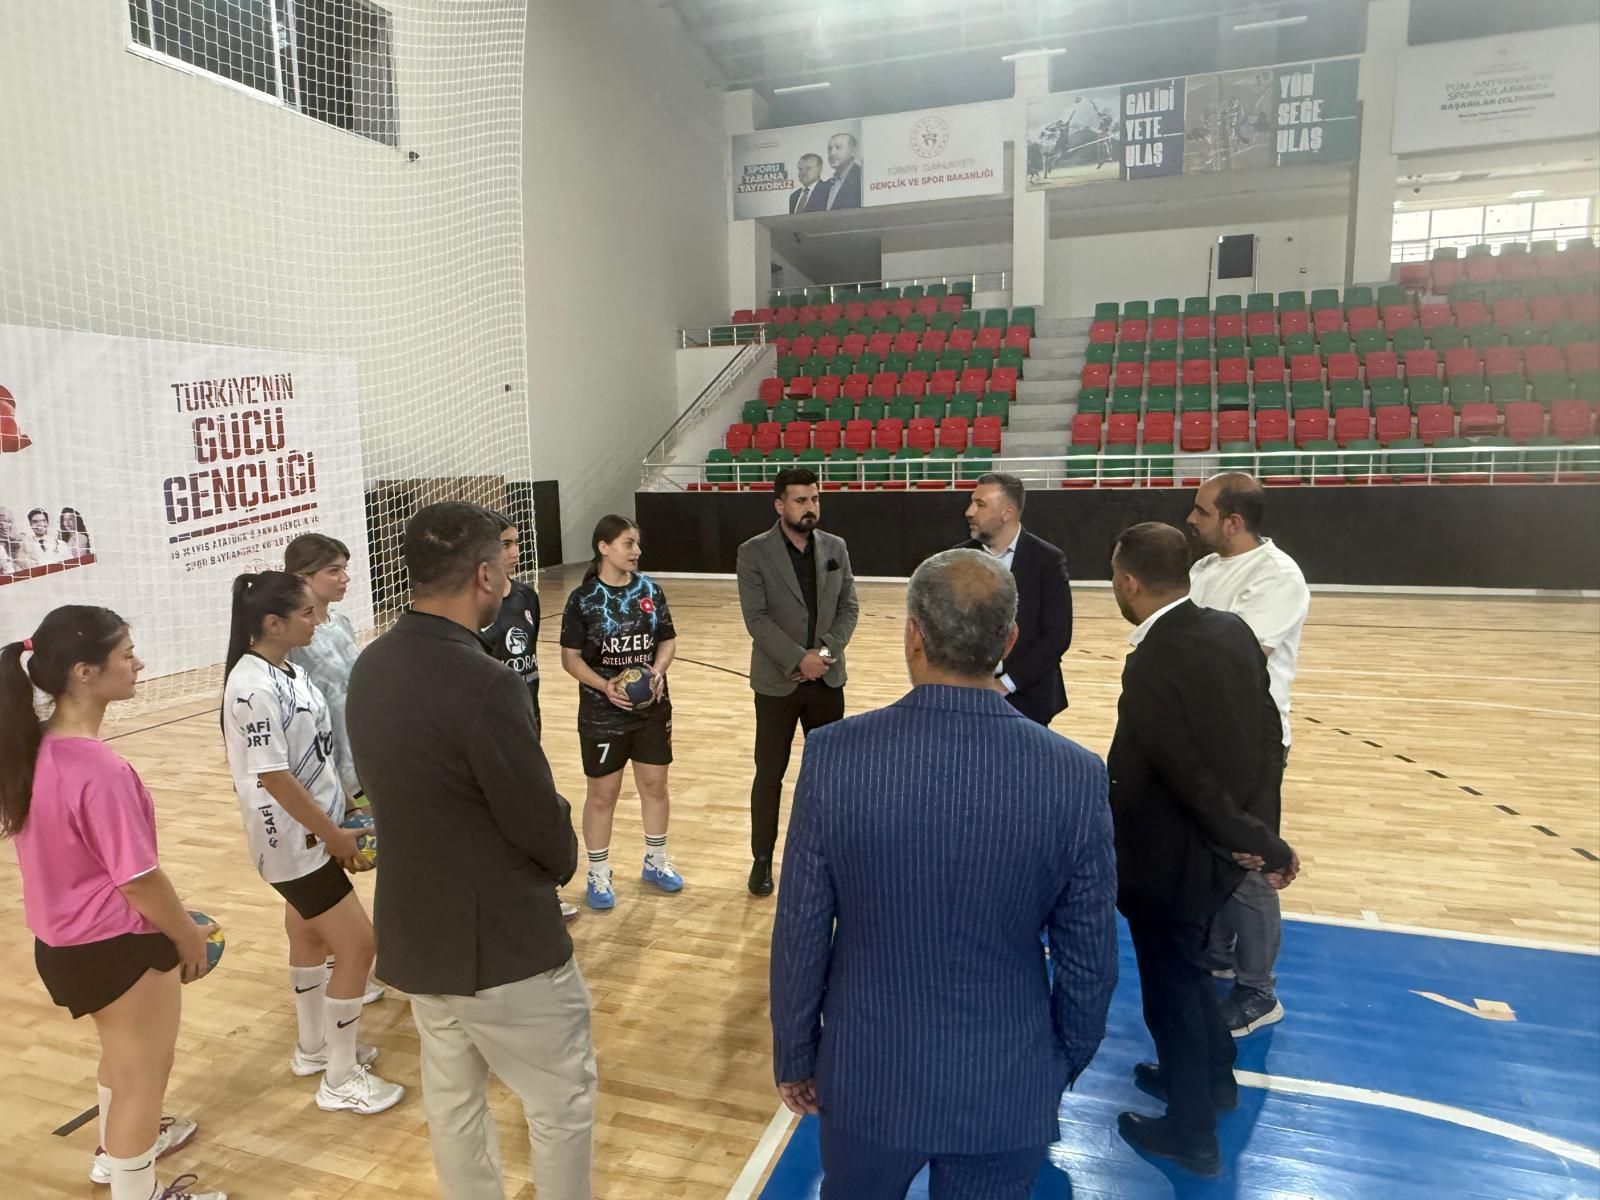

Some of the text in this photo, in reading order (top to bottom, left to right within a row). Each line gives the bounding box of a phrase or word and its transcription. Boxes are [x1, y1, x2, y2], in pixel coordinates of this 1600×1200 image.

[1278, 98, 1324, 125] SEĞE
[1126, 116, 1162, 141] YETE
[1277, 127, 1322, 153] ULAŞ
[1126, 142, 1163, 167] ULAŞ
[870, 169, 994, 191] GENÇLİK VE SPOR BAKANLIĞI
[171, 373, 294, 412] TÜRKİYE'NİN
[192, 407, 286, 464] GÜCÜ
[163, 450, 317, 524] GENÇLİĞİ
[183, 541, 210, 557] MAYIS
[597, 744, 610, 764] 7
[258, 804, 277, 834] SAFİ
